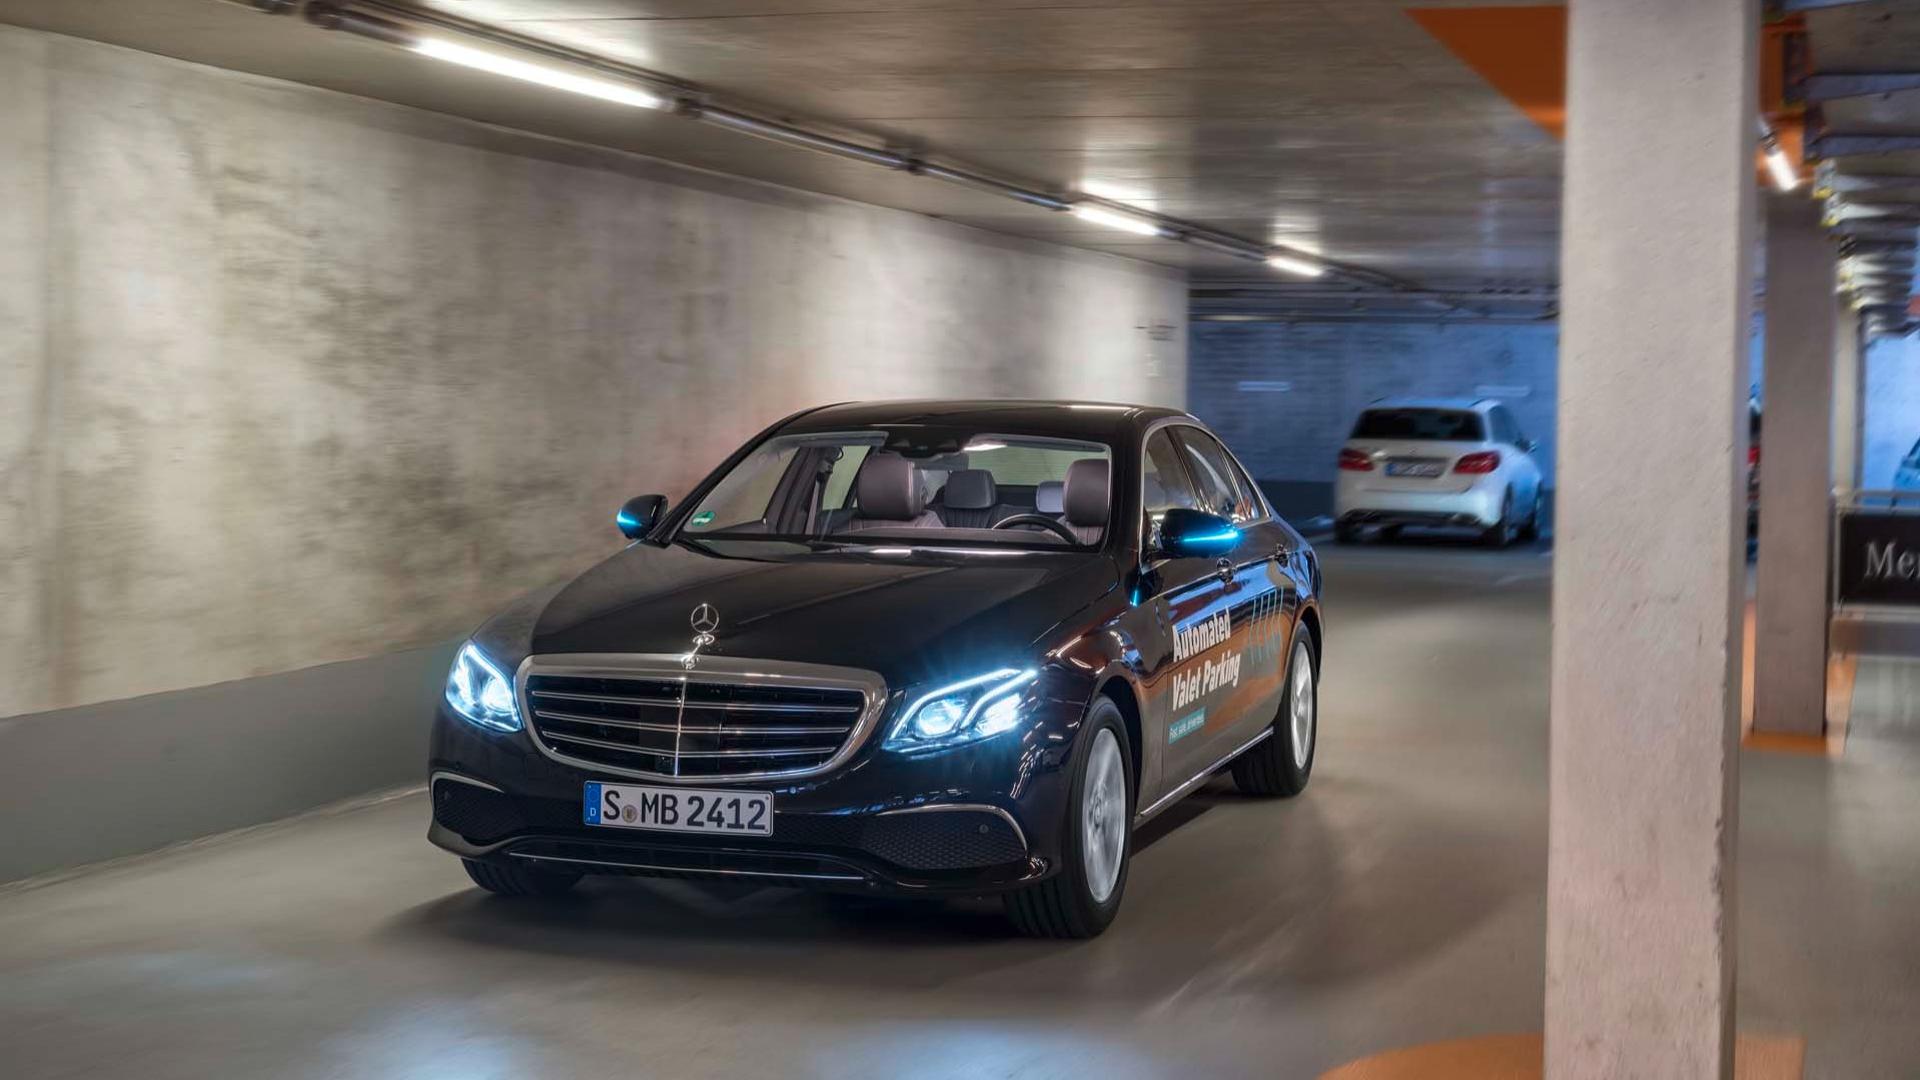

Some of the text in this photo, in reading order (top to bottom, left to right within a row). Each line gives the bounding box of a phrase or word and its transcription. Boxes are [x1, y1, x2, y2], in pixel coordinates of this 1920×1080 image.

[1864, 541, 1920, 579] Me
[1172, 605, 1231, 663] Automated
[1172, 650, 1241, 712] Valet Parking
[590, 807, 597, 817] D
[686, 796, 766, 830] 2412
